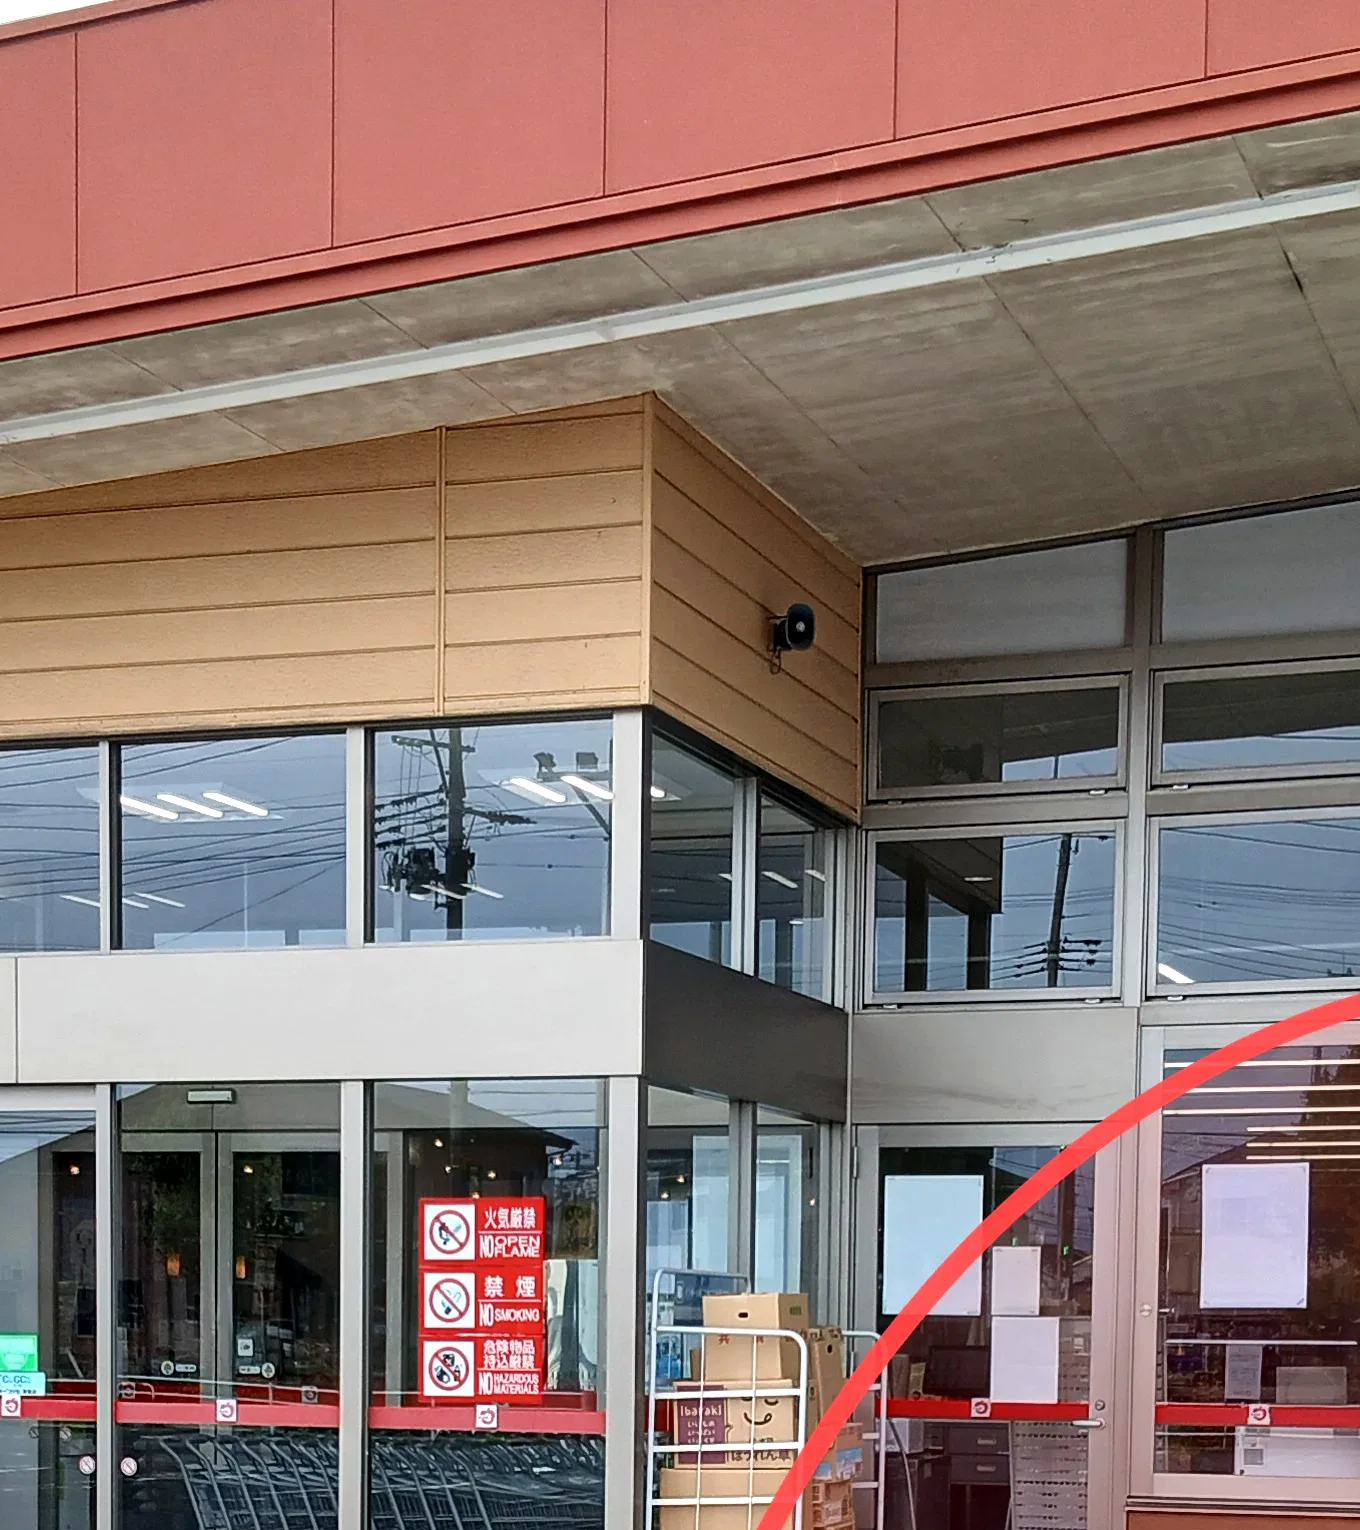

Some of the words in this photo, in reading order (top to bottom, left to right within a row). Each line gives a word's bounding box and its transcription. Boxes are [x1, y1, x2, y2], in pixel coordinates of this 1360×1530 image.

[484, 1207, 536, 1229] 火気厳禁
[480, 1235, 494, 1258] NO
[495, 1236, 540, 1247] OPEN
[495, 1246, 540, 1257] FLAME
[484, 1276, 536, 1298] 禁煙
[480, 1303, 494, 1327] NO
[495, 1309, 540, 1322] SMOKING
[479, 1372, 492, 1395] NO
[493, 1373, 539, 1384] HAZARDOUS
[493, 1383, 539, 1394] MATERIALS
